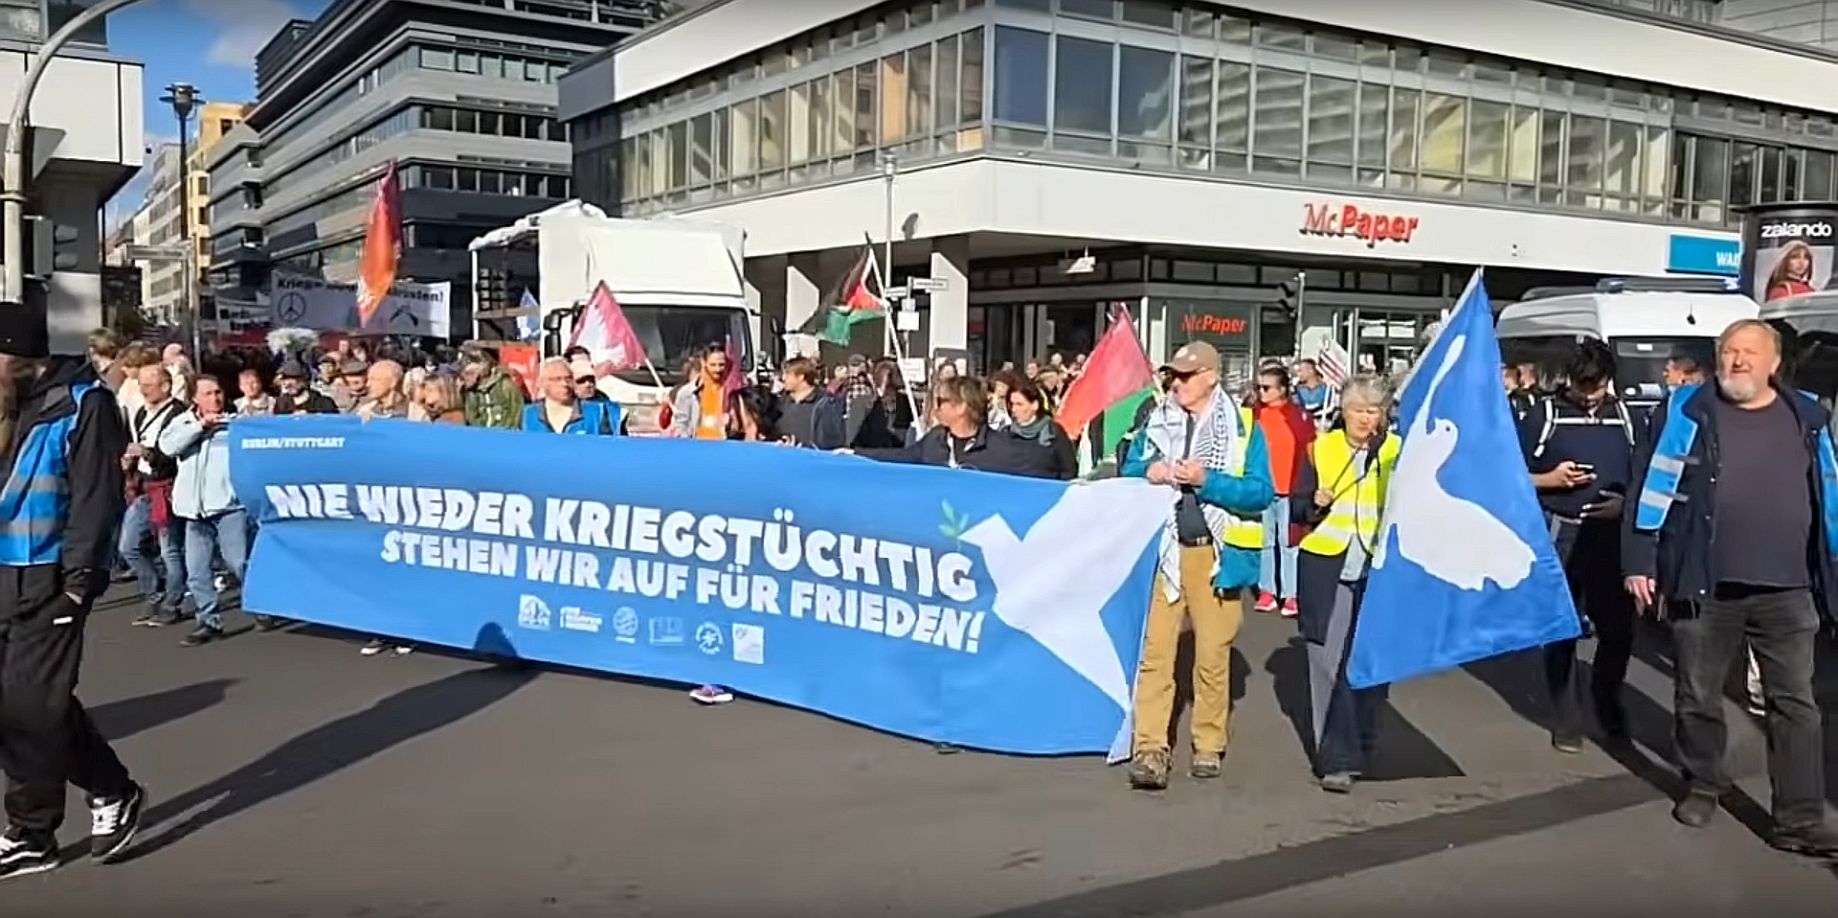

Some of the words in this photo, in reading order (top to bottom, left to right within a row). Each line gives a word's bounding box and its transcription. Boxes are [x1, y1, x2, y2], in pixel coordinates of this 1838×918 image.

[1302, 203, 1419, 247] McPaper
[1761, 222, 1832, 238] zalando
[1181, 314, 1247, 335] McPaper
[265, 484, 354, 519] NIE
[355, 484, 533, 540] WIEDER
[544, 497, 979, 602] KRIEGSTÜCHTIG
[381, 531, 517, 577] STEHEN
[525, 546, 601, 589] WIR
[606, 556, 690, 600] AUF
[695, 564, 782, 616] FÜR
[790, 579, 986, 654] FRIEDEN!
